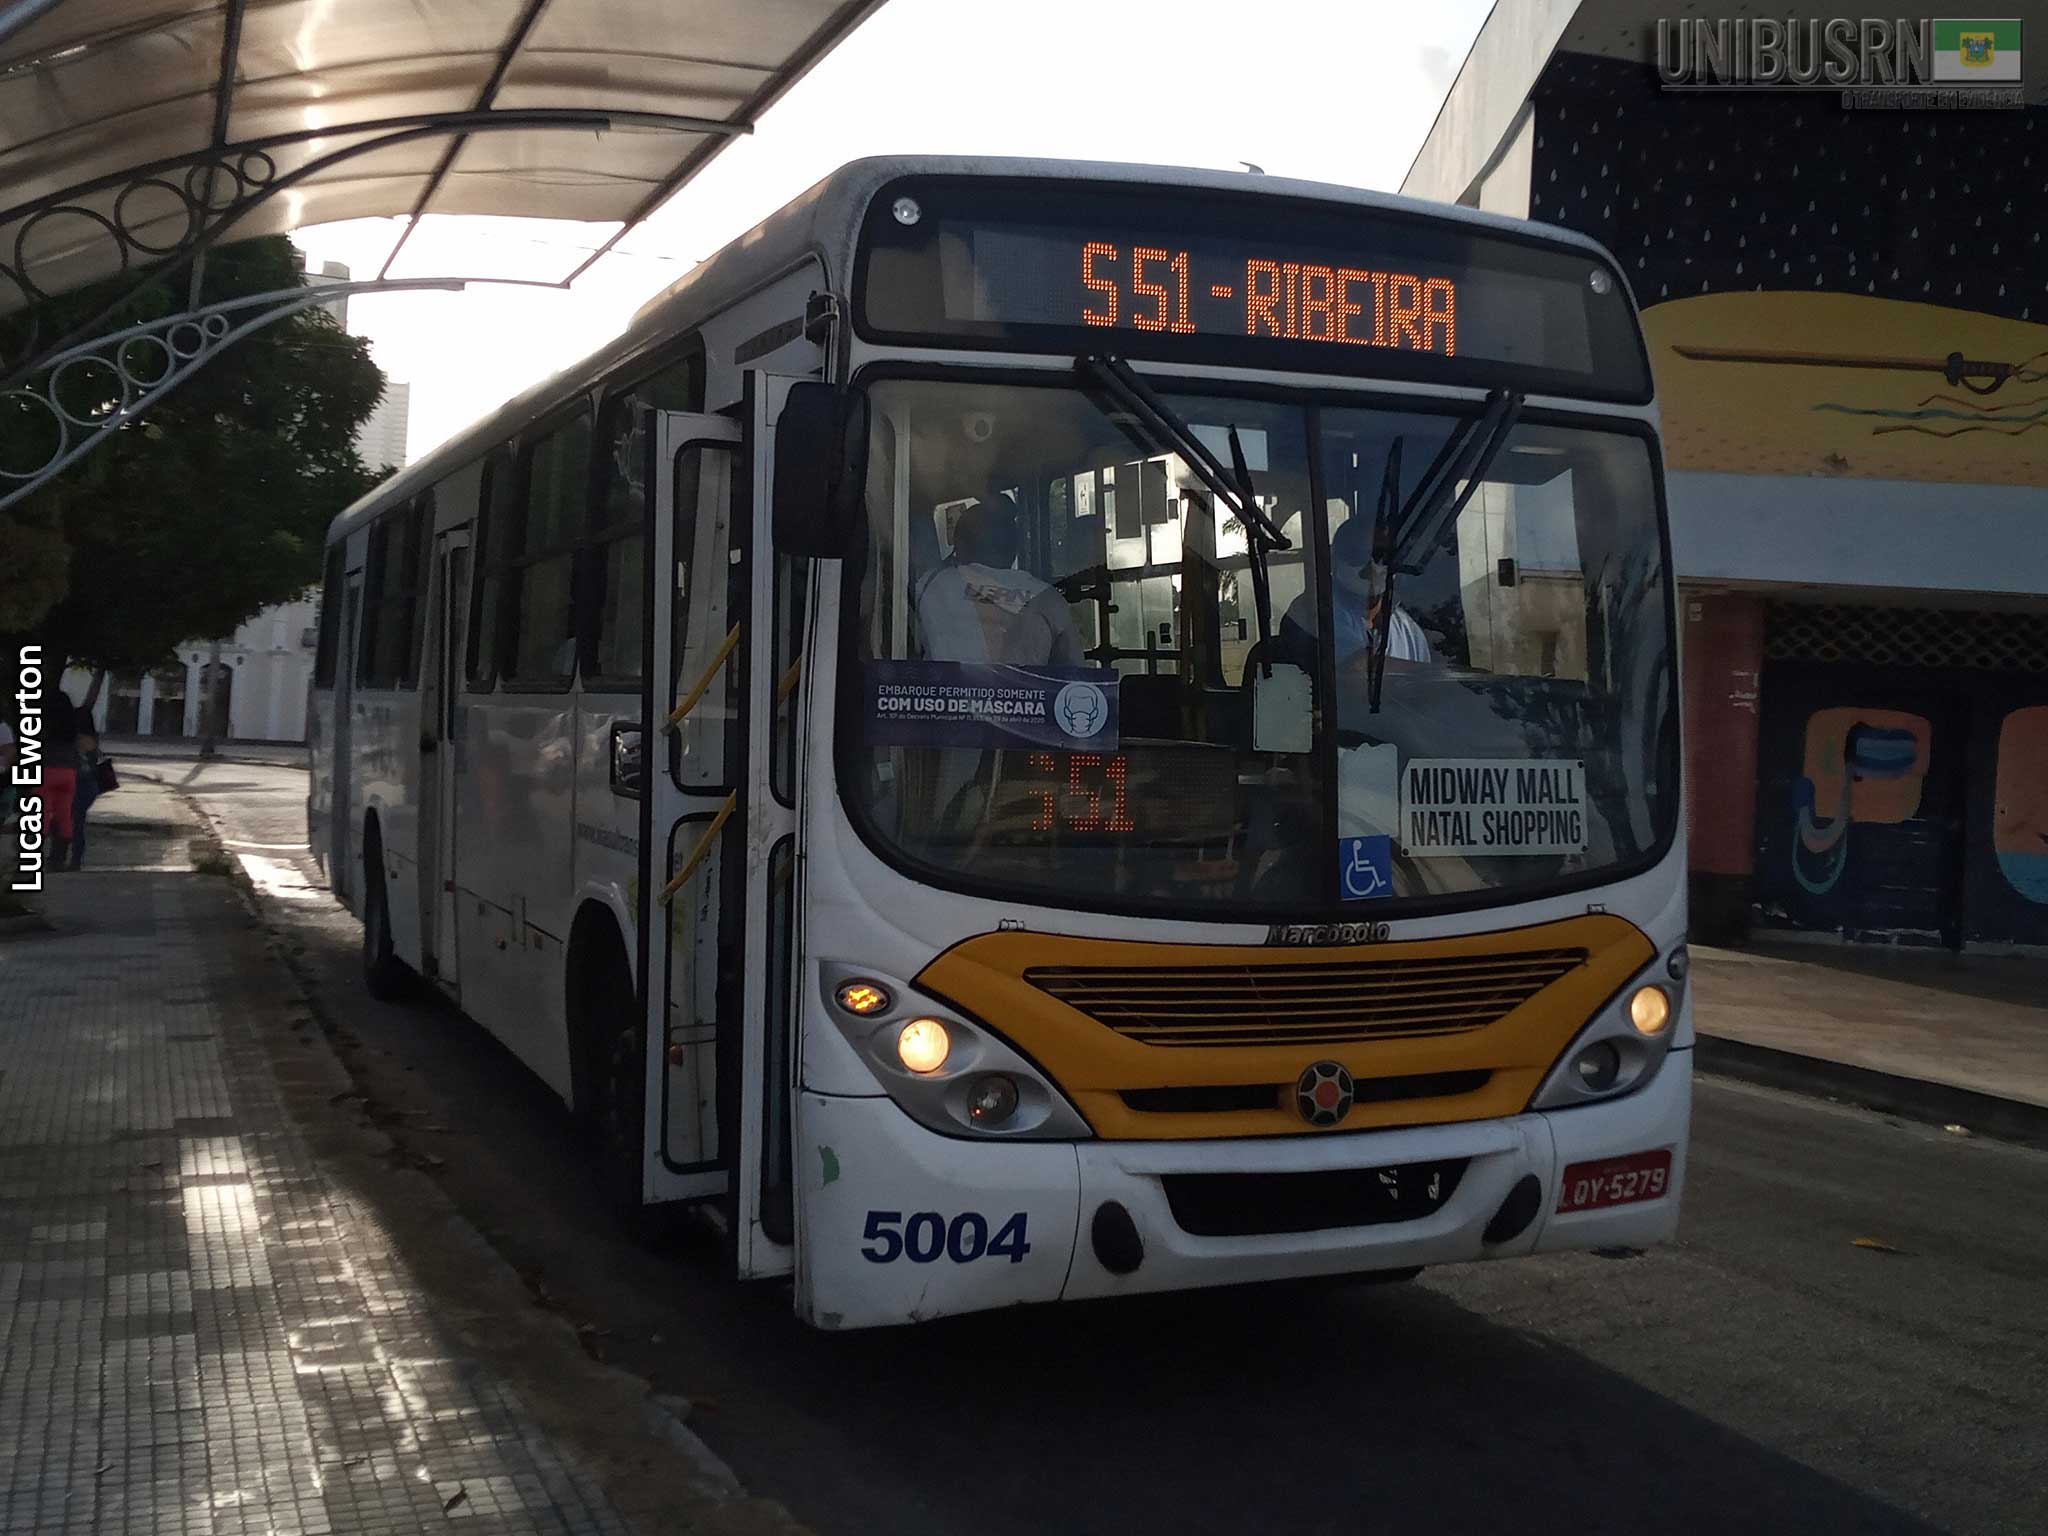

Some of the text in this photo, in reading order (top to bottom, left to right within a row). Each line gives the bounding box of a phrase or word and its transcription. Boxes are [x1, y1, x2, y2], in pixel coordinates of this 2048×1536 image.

[1247, 258, 1455, 358] RIBEIRA
[877, 697, 1046, 716] COM USO DE MÁSCARA
[878, 685, 1046, 700] EMBARQUE PERMITIDO SOMENTE
[1410, 768, 1579, 805] MIDWAY MALL
[1411, 810, 1581, 846] NATAL SHOPPING
[1267, 923, 1390, 945] Marcopolo
[861, 1211, 1031, 1264] 5004
